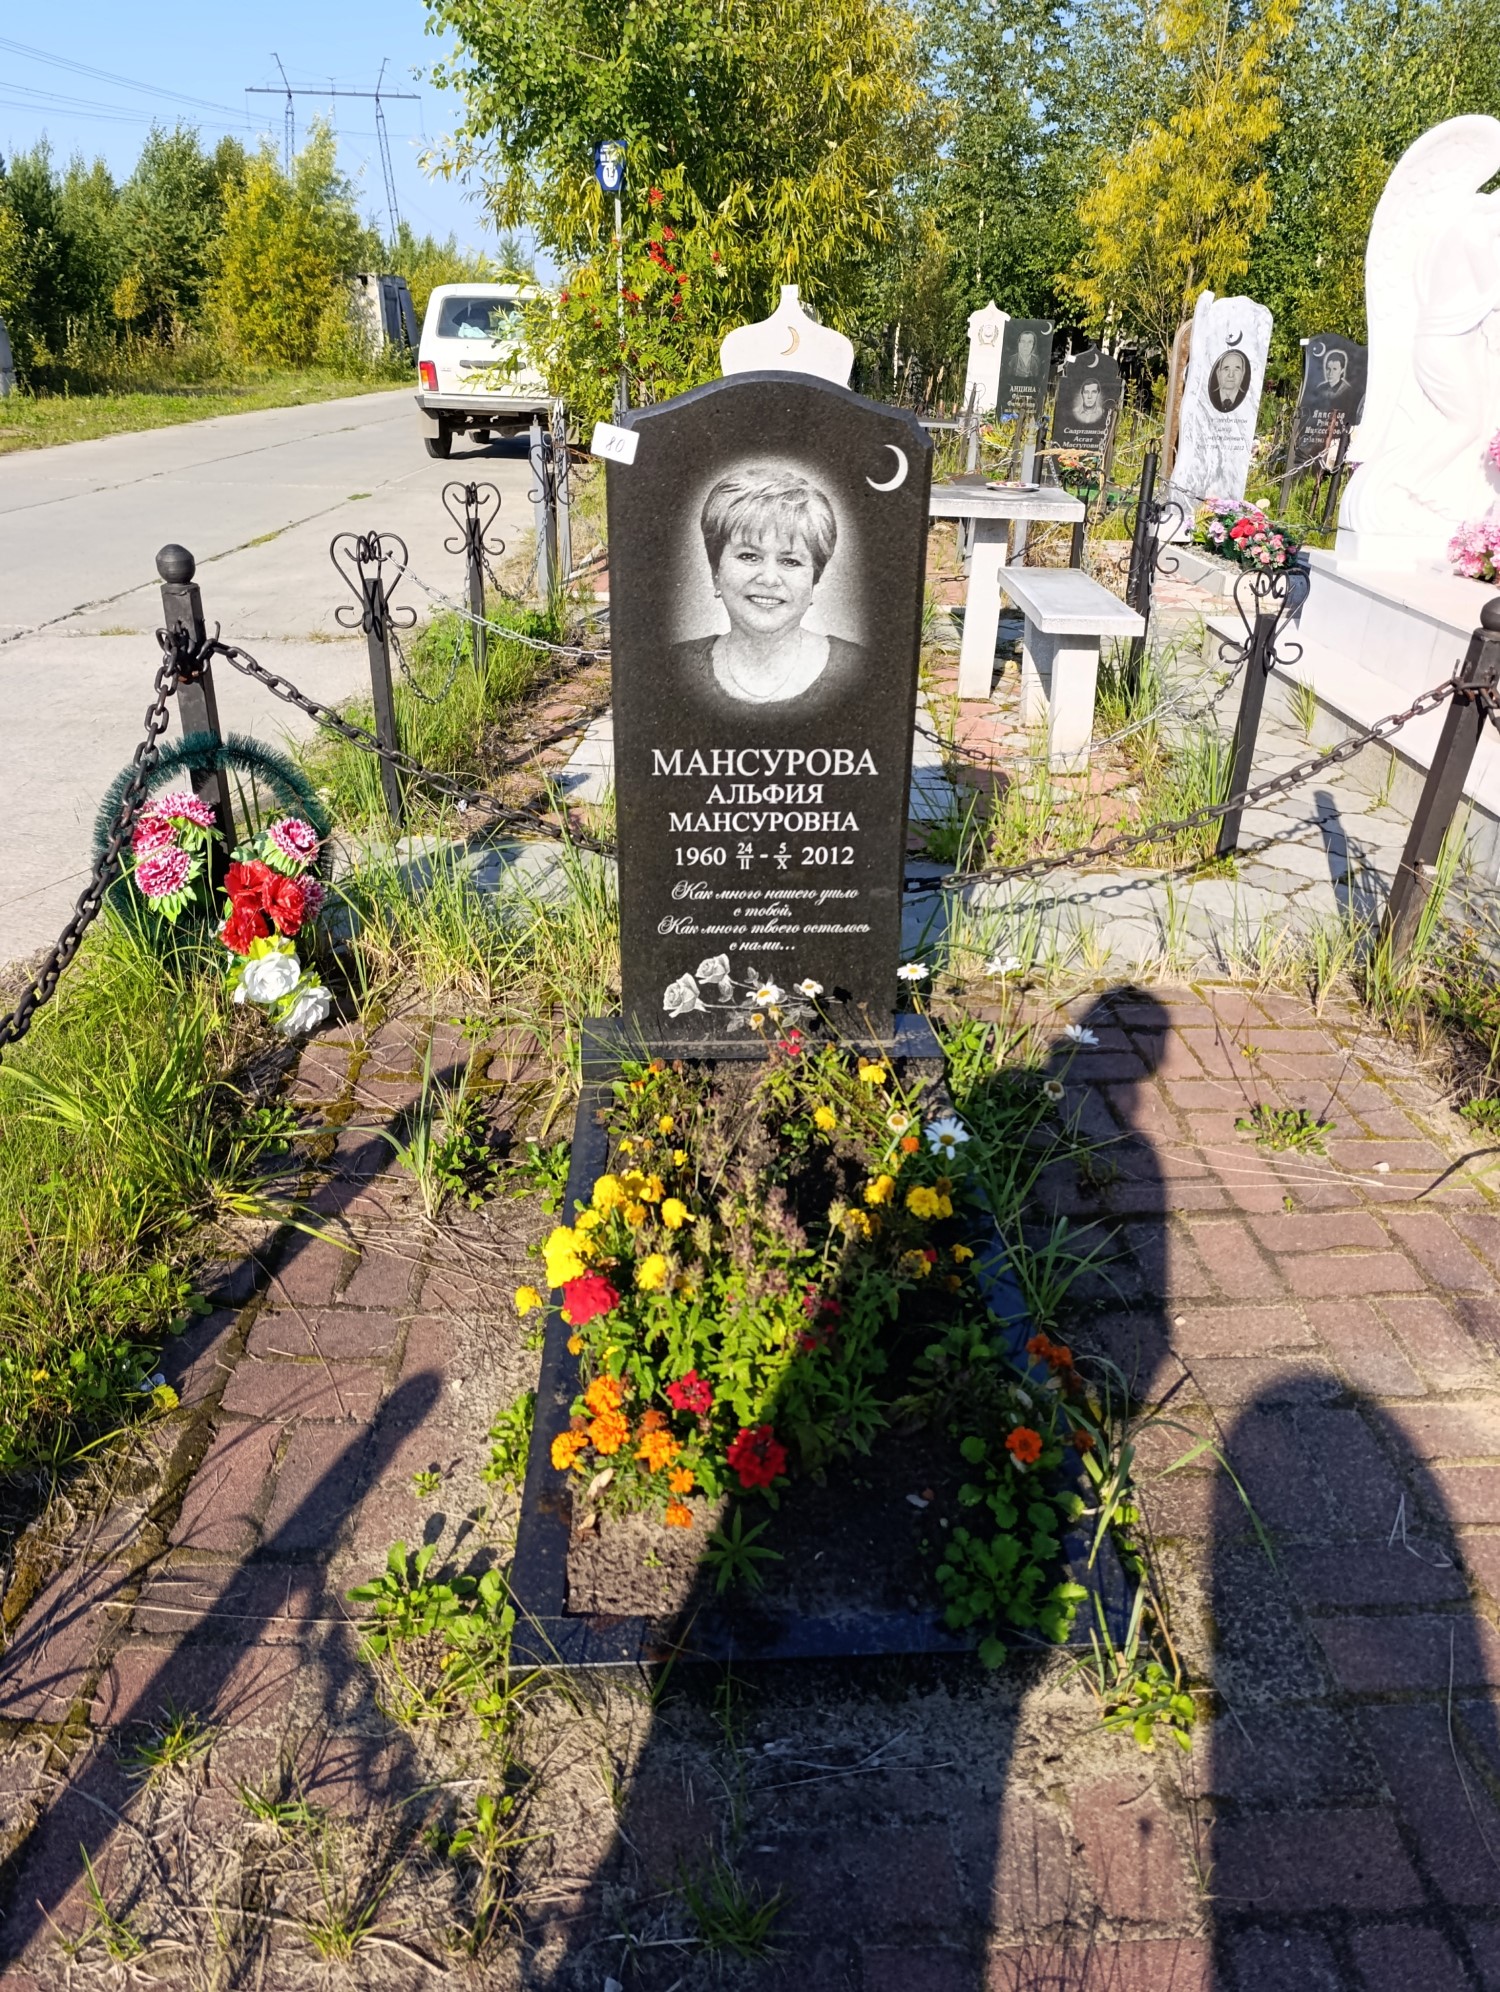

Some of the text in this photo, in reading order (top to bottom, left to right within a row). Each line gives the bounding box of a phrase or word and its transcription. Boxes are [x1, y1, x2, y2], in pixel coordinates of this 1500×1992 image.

[651, 748, 879, 776] МАНСУРОВА
[706, 783, 824, 805] АЛЬФИЯ
[668, 811, 860, 833] МАНСУРОВНА
[675, 846, 727, 867] 1960
[801, 846, 855, 866] 2012
[671, 880, 859, 906] Как много нашего ушло
[733, 902, 793, 918] с тобой,
[657, 915, 871, 936] Как много твоего осталось
[729, 941, 796, 952] с нами...
